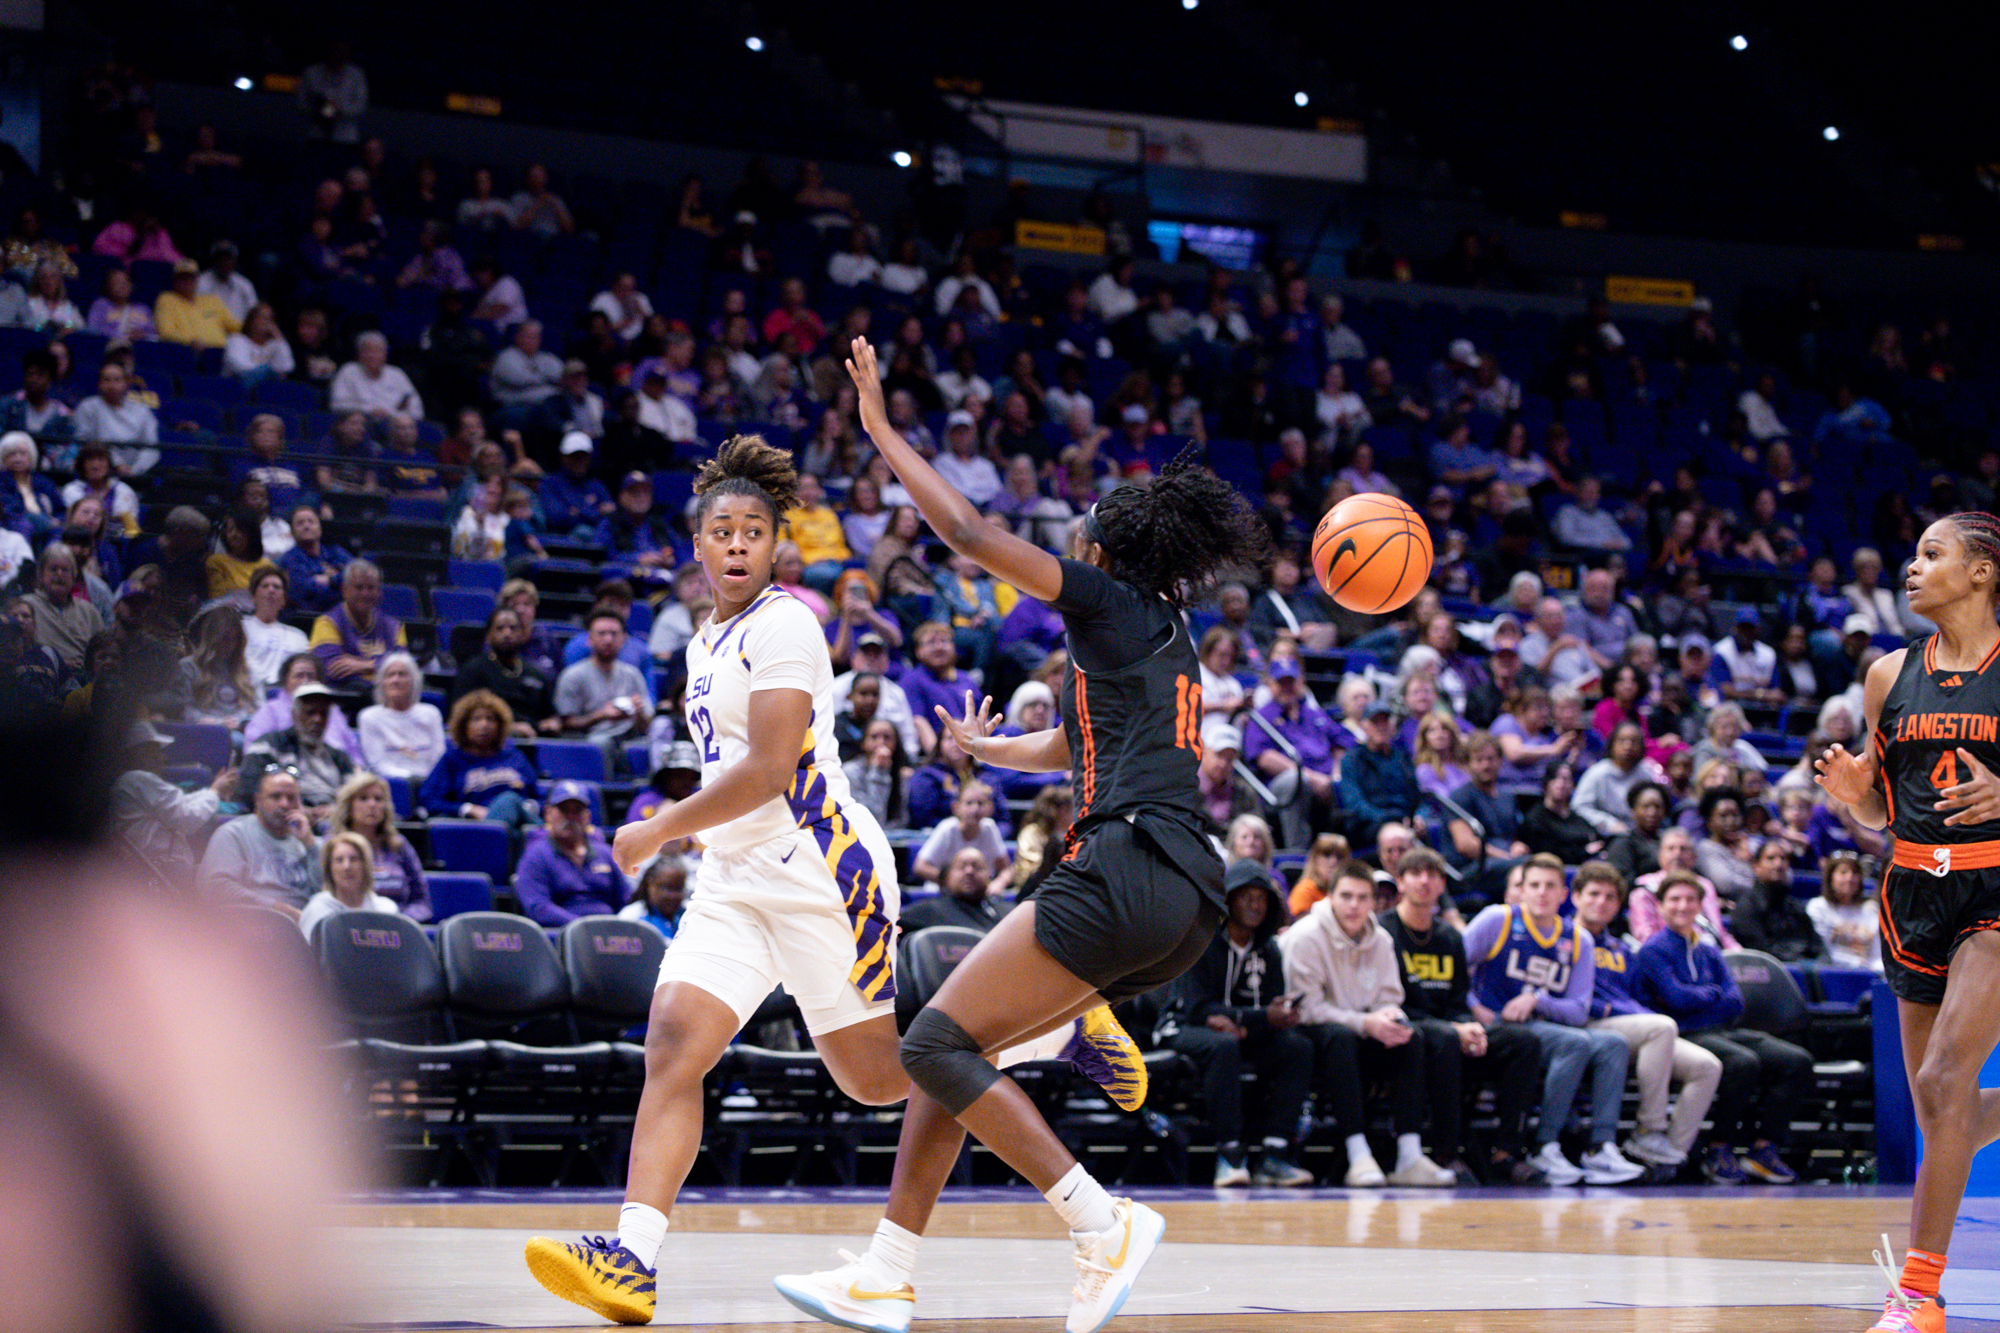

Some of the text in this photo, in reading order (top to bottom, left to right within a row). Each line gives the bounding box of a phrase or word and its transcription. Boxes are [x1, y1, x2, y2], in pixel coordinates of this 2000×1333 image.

[1174, 673, 1205, 761] 10
[1896, 712, 1998, 743] LANGSTON
[689, 705, 720, 764] 12
[1929, 750, 1959, 800] 4
[350, 928, 401, 949] LSU
[472, 932, 523, 952] LSU
[592, 935, 643, 955] LSU
[937, 944, 972, 963] LS
[1402, 949, 1455, 981] LSU
[1506, 949, 1572, 993] LSU
[1594, 946, 1627, 974] SU
